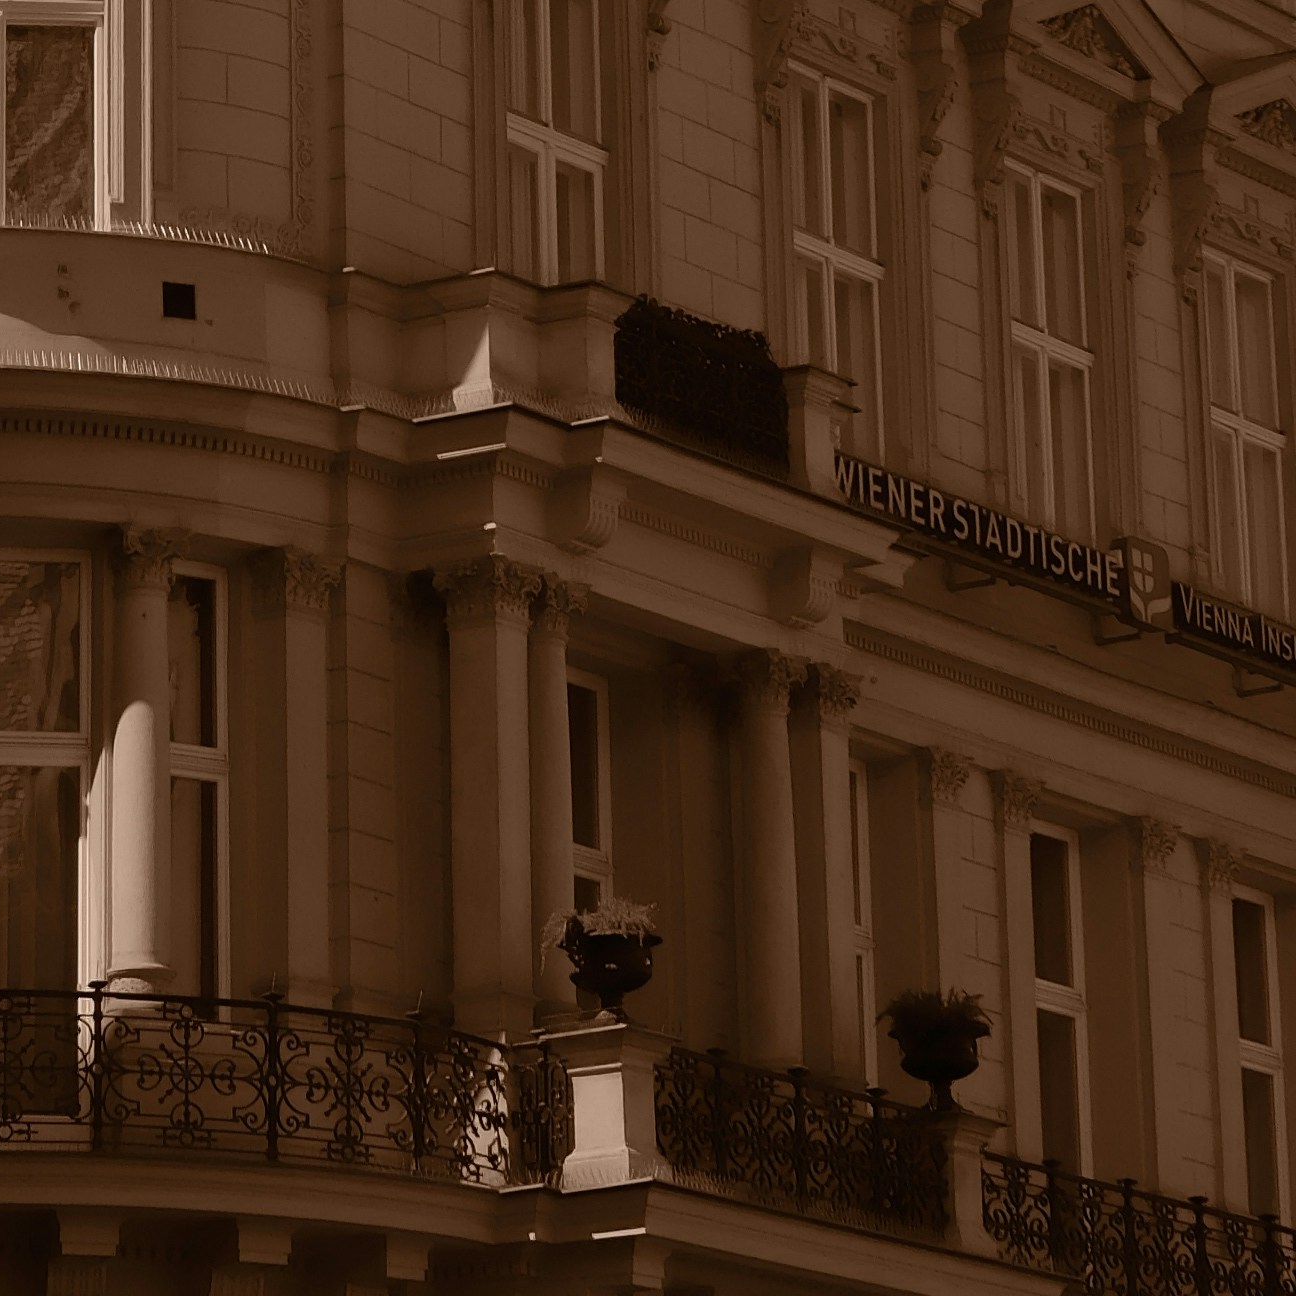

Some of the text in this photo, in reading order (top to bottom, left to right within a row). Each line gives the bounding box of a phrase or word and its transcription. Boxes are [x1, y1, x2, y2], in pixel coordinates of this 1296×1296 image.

[833, 455, 1121, 597] WIENER STÄDTISCHE
[1260, 614, 1296, 662] INS
